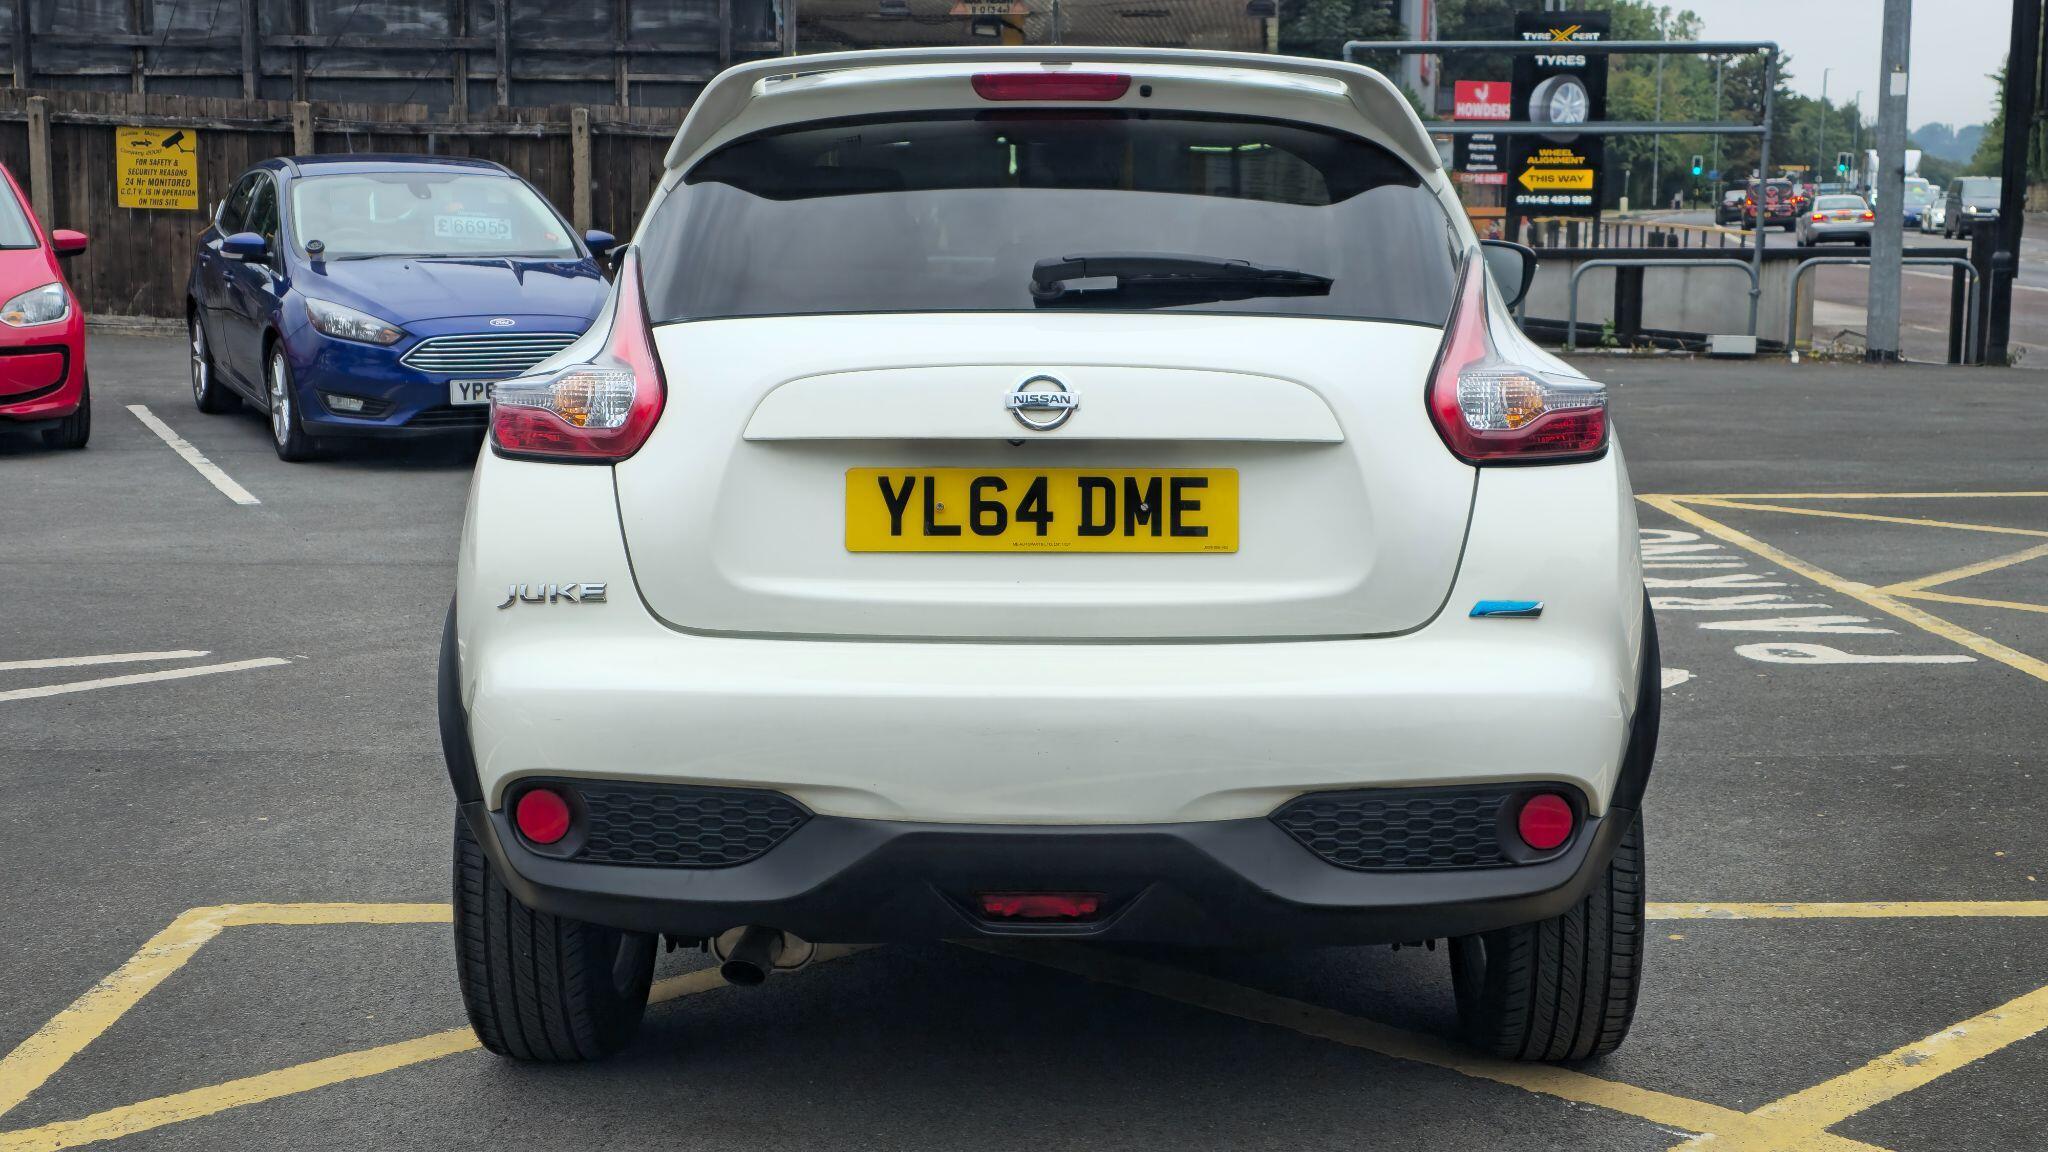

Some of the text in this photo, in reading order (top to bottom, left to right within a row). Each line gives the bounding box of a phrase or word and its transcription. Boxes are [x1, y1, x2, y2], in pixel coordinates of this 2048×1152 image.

[1534, 54, 1586, 66] TYRES
[1456, 102, 1511, 117] HOWDENS
[1538, 148, 1574, 156] WHEEL
[135, 158, 179, 167] FOR SAFETY &
[1526, 156, 1586, 164] ALIGNMENT
[127, 168, 188, 177] SECURITY REASONS
[125, 177, 191, 188] 24 Hr MONITORED
[1528, 174, 1585, 183] THIS WAY
[145, 188, 152, 196] IS
[153, 188, 160, 196] IN
[161, 188, 196, 197] OPERATION
[138, 198, 179, 207] ON THIS SITE
[1013, 394, 1071, 404] NISSAN
[877, 476, 1208, 537] YL64 DME
[496, 582, 607, 609] JUKE
